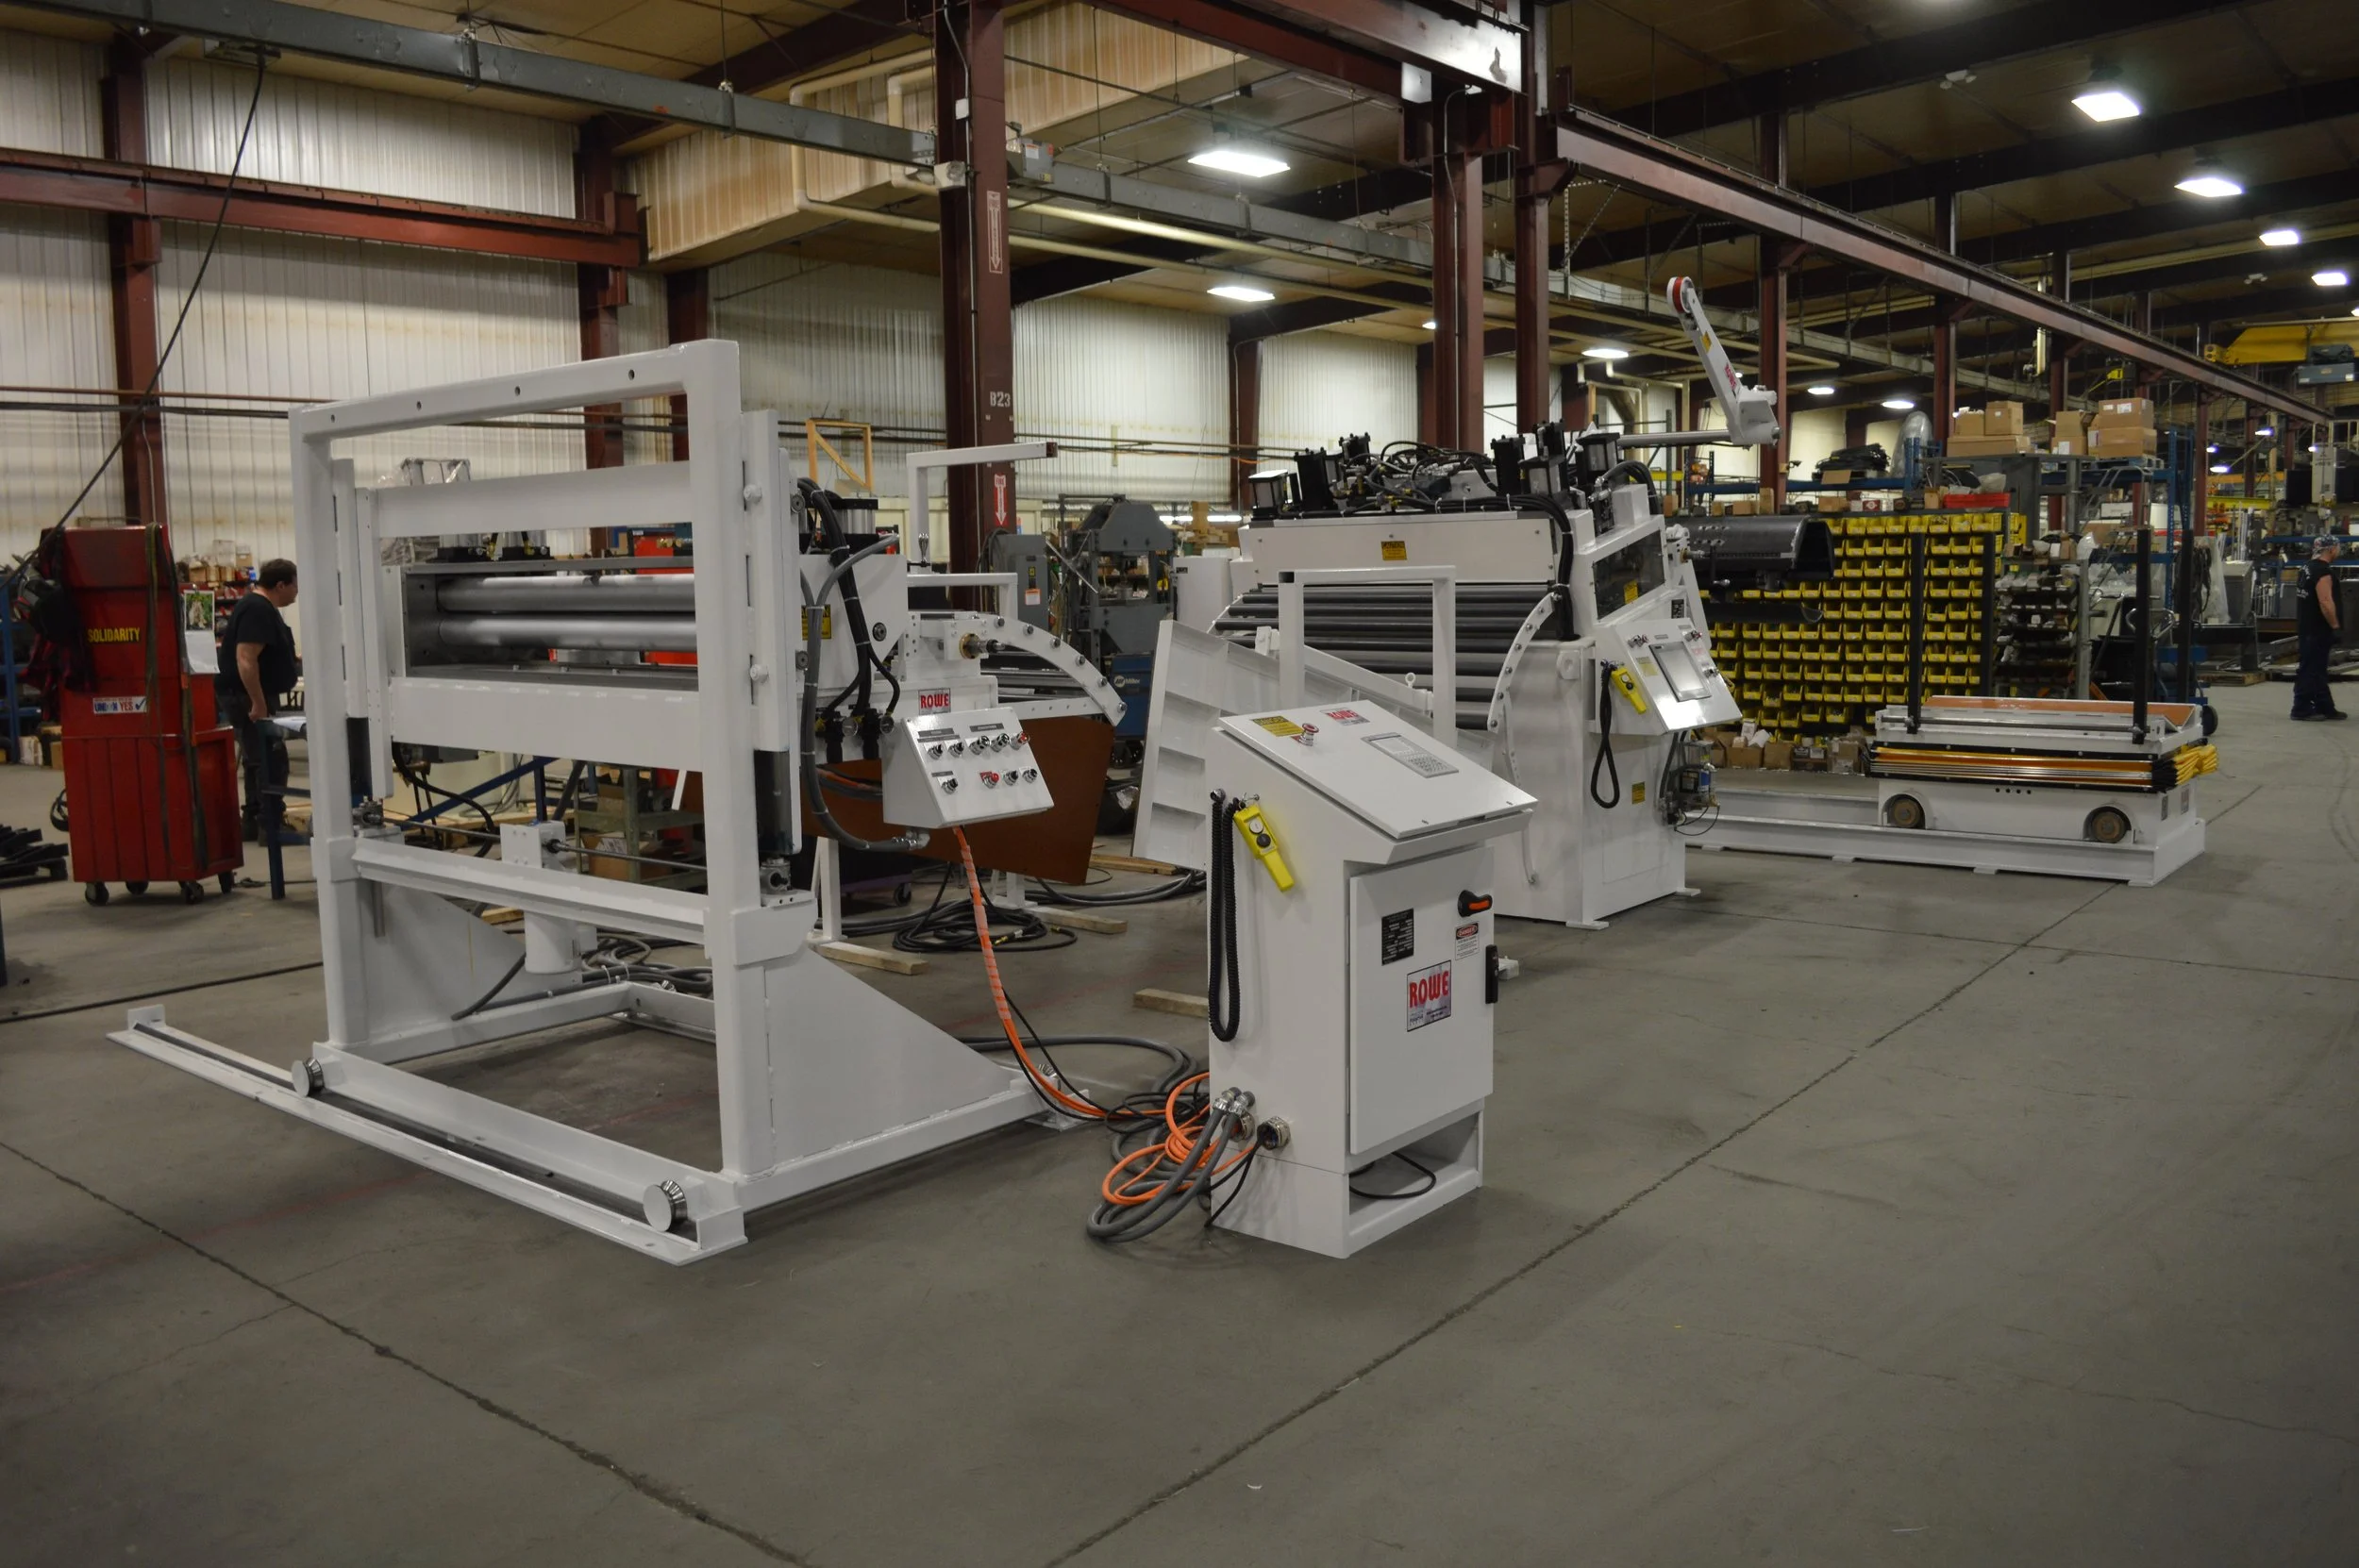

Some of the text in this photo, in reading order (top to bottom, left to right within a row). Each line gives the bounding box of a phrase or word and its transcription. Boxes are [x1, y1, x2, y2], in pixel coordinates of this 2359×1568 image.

[990, 391, 1011, 408] B23
[88, 627, 140, 642] SOLIDARITY
[119, 702, 134, 711] YES
[920, 693, 949, 709] ROWE
[1409, 970, 1449, 1009] ROWE
